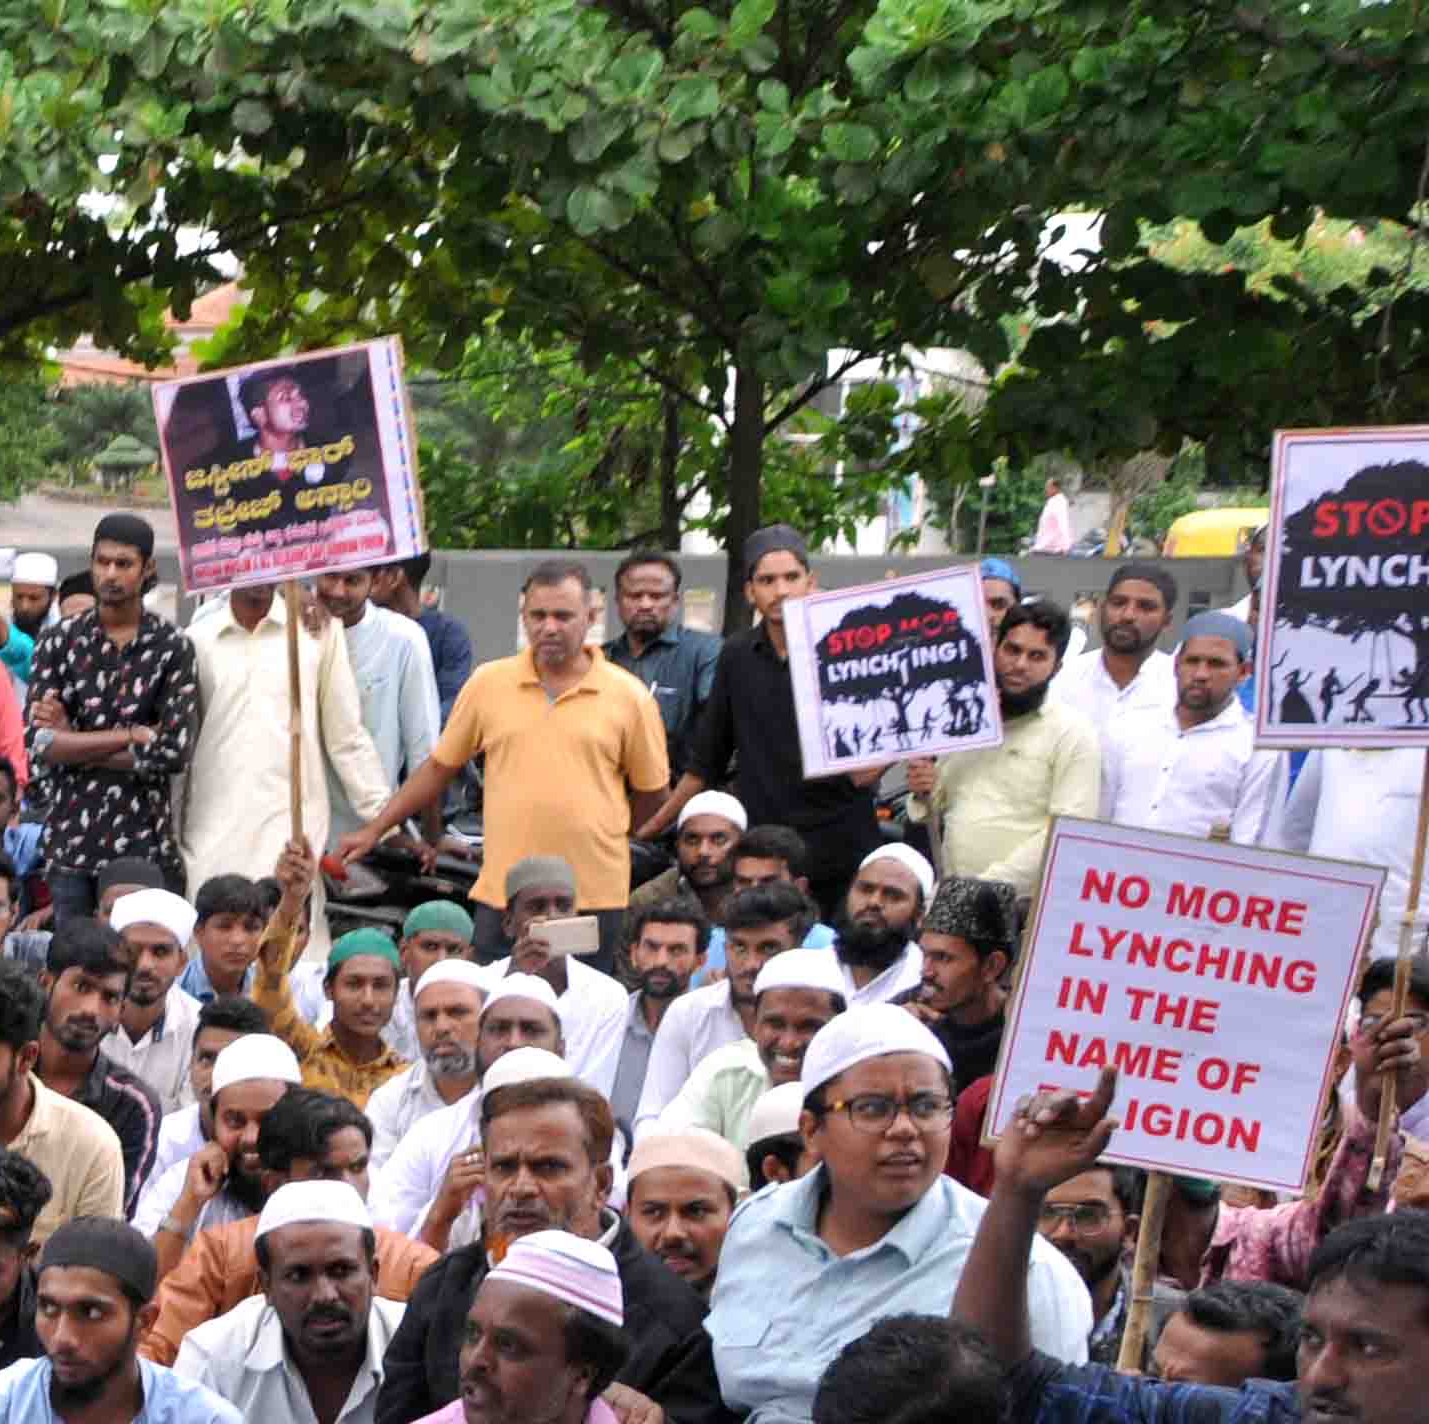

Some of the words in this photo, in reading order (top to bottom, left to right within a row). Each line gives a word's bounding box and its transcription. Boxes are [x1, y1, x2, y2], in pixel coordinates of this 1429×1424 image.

[1313, 499, 1429, 537] STOP
[827, 623, 892, 656] STOP
[1080, 868, 1151, 909] NO
[1166, 882, 1307, 937] MORE
[1068, 923, 1318, 994] LYNCHING
[1057, 976, 1109, 1016] IN
[1125, 987, 1220, 1034] THE
[1045, 1030, 1183, 1084] NAME
[1197, 1058, 1261, 1096] OF
